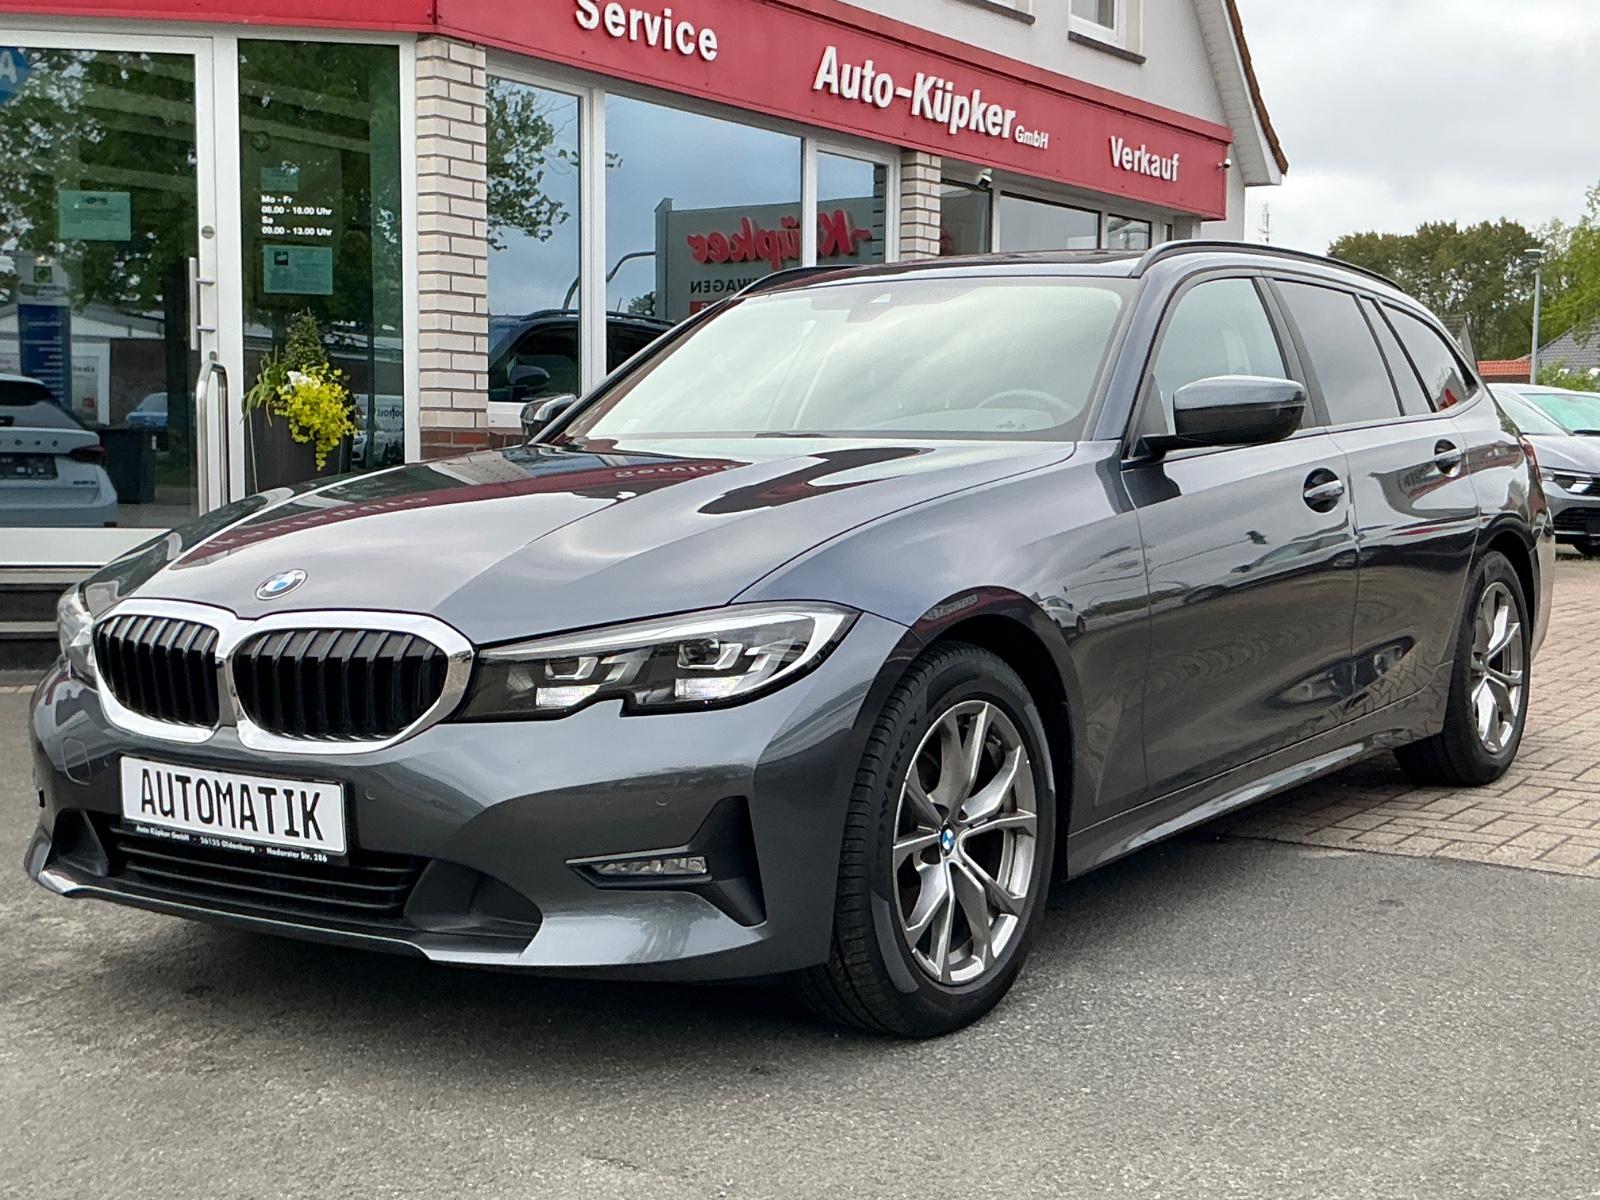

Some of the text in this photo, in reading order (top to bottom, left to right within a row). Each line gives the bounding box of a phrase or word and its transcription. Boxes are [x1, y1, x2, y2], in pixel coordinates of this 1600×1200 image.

[575, 0, 718, 61] Service
[812, 46, 1049, 149] Auto-Küpker GmbH
[1109, 135, 1180, 181] Verkauf
[261, 195, 276, 204] Mo
[283, 195, 293, 204] Fr
[316, 207, 333, 216] Uhr
[261, 215, 274, 224] Sa
[316, 227, 333, 236] Uhr
[141, 768, 324, 841] AUTOMATIK
[221, 840, 256, 854] Oldenburg
